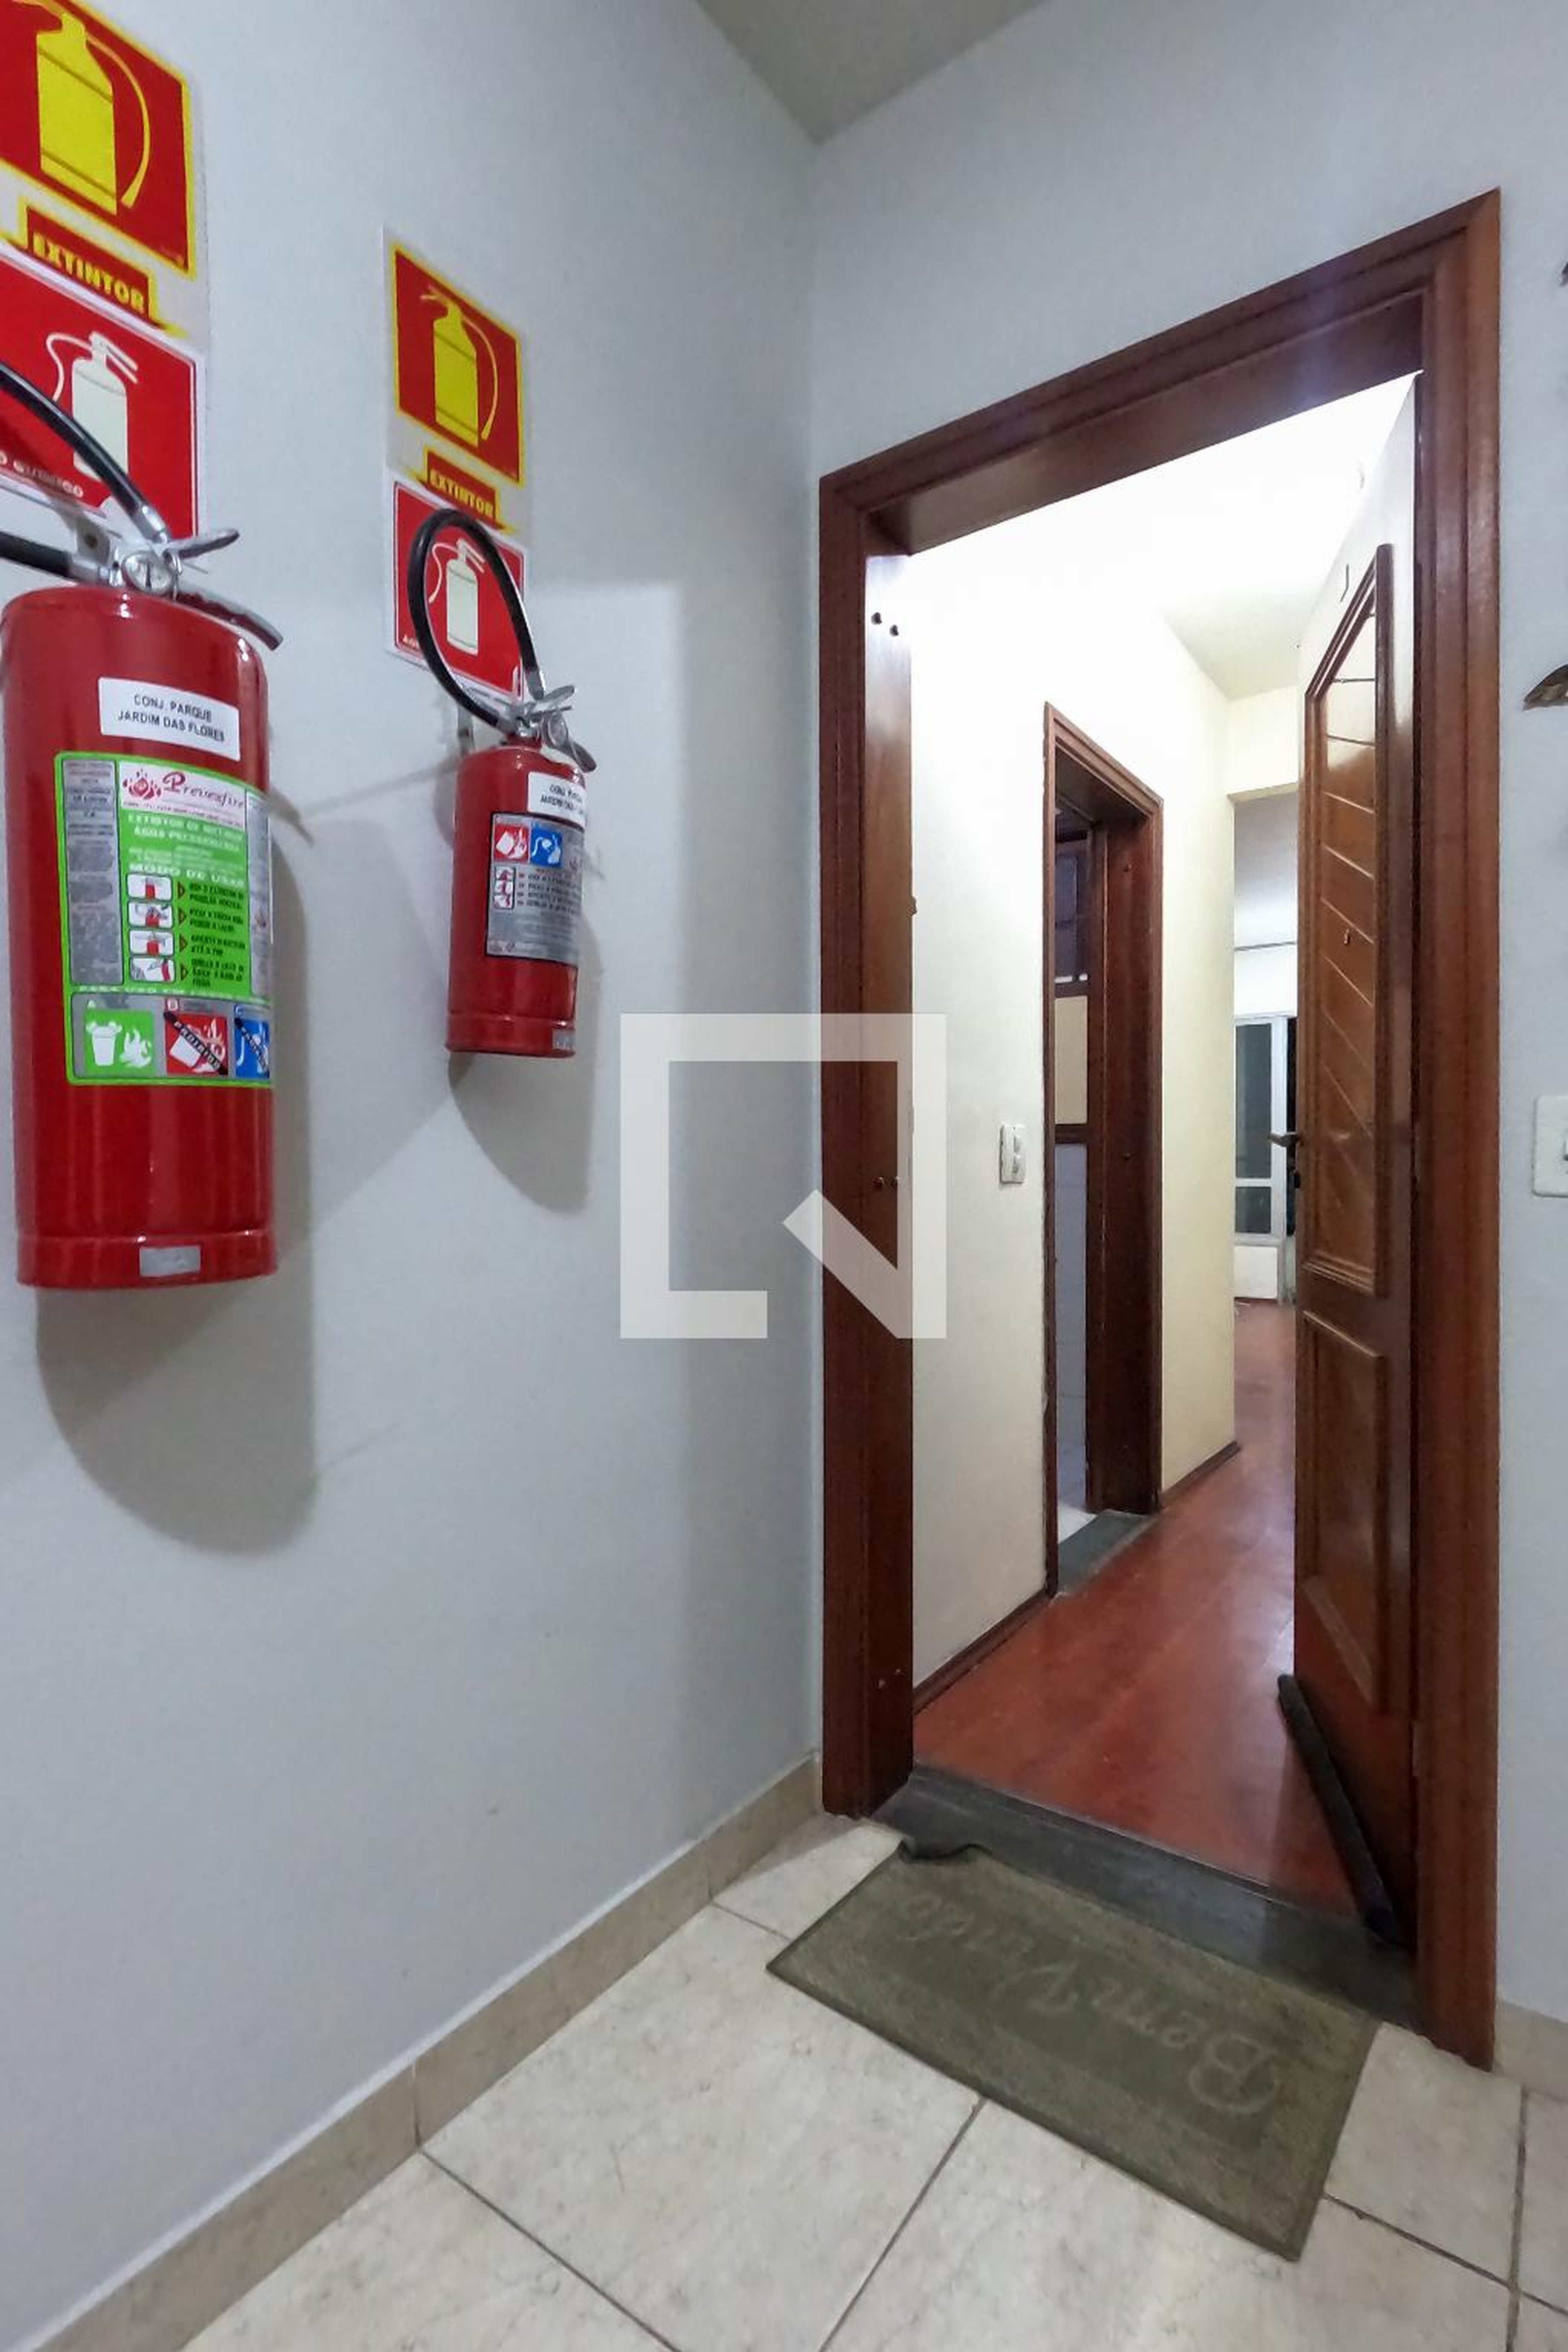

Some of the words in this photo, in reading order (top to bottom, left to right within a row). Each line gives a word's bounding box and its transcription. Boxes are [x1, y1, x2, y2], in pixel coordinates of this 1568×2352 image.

[33, 232, 144, 314] EXTINTOR
[430, 470, 493, 518] EXTINTOR
[118, 711, 160, 725] JARDIM
[164, 717, 185, 731] DAS
[188, 723, 225, 742] FLORES
[170, 701, 212, 722] PARQUE
